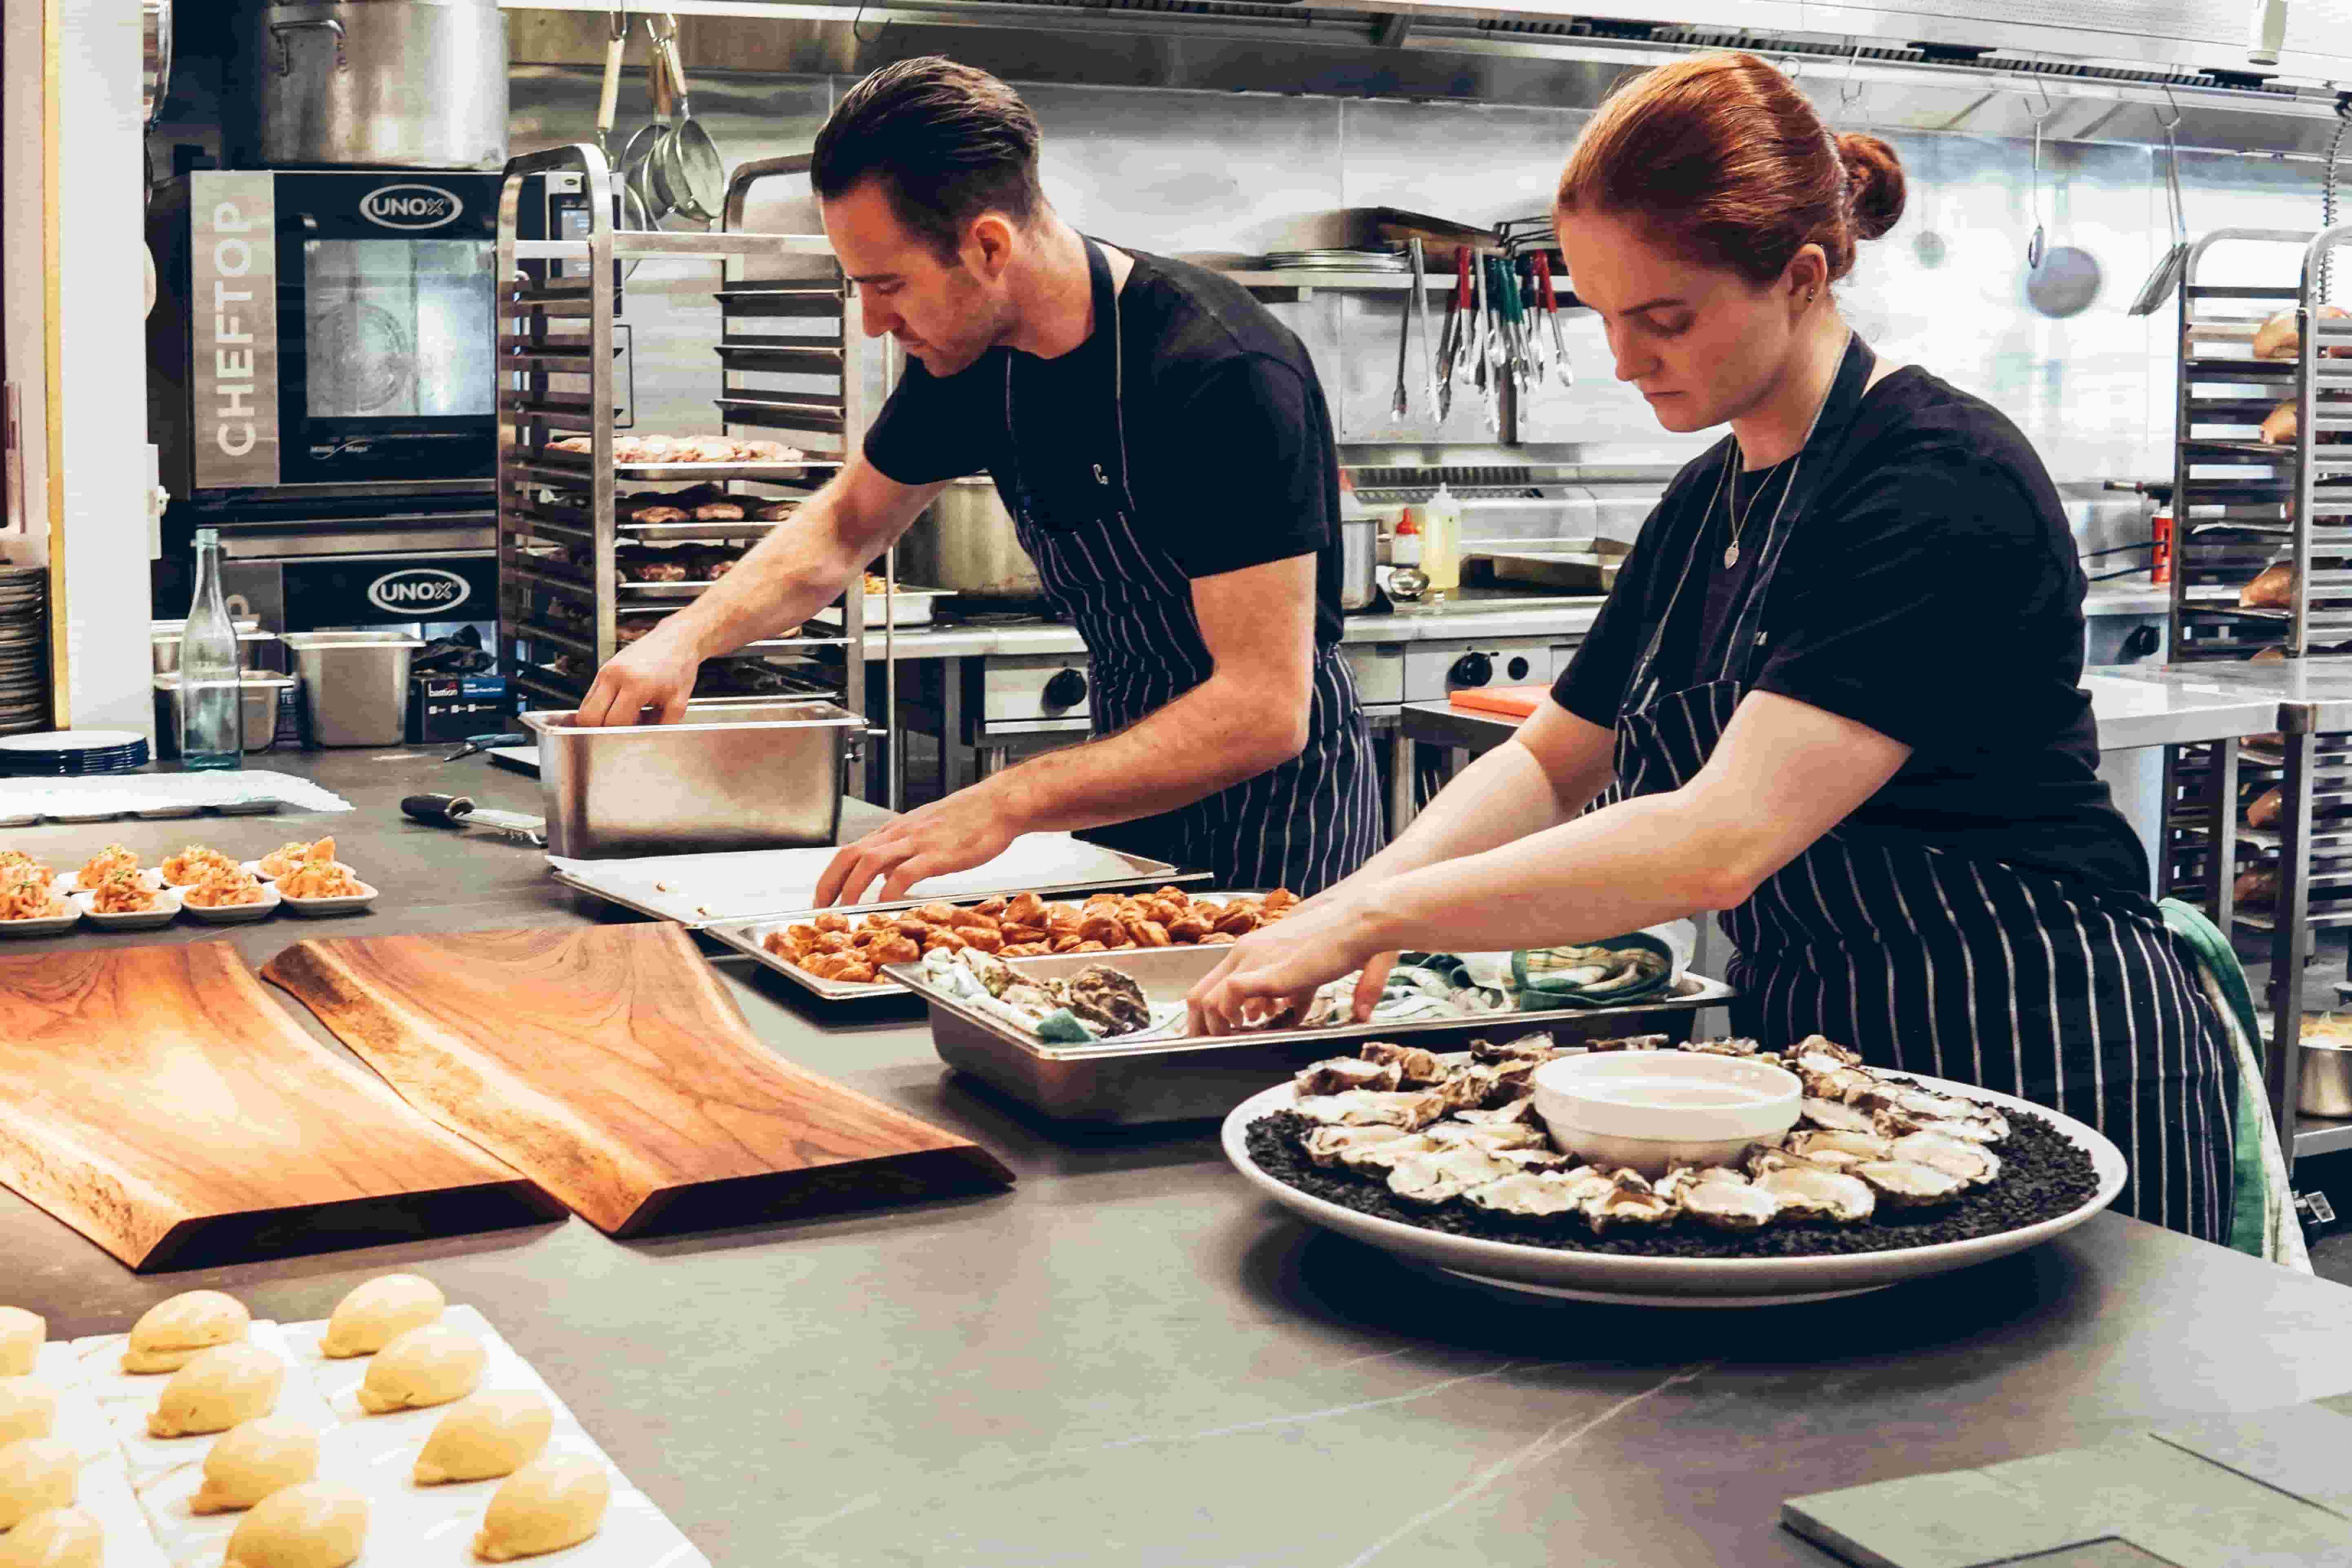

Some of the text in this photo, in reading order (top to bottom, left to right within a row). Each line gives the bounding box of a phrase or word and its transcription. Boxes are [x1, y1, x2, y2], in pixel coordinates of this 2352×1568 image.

[372, 197, 444, 215] UNOX
[214, 202, 256, 456] CHEFTOP
[380, 582, 452, 601] UNOX
